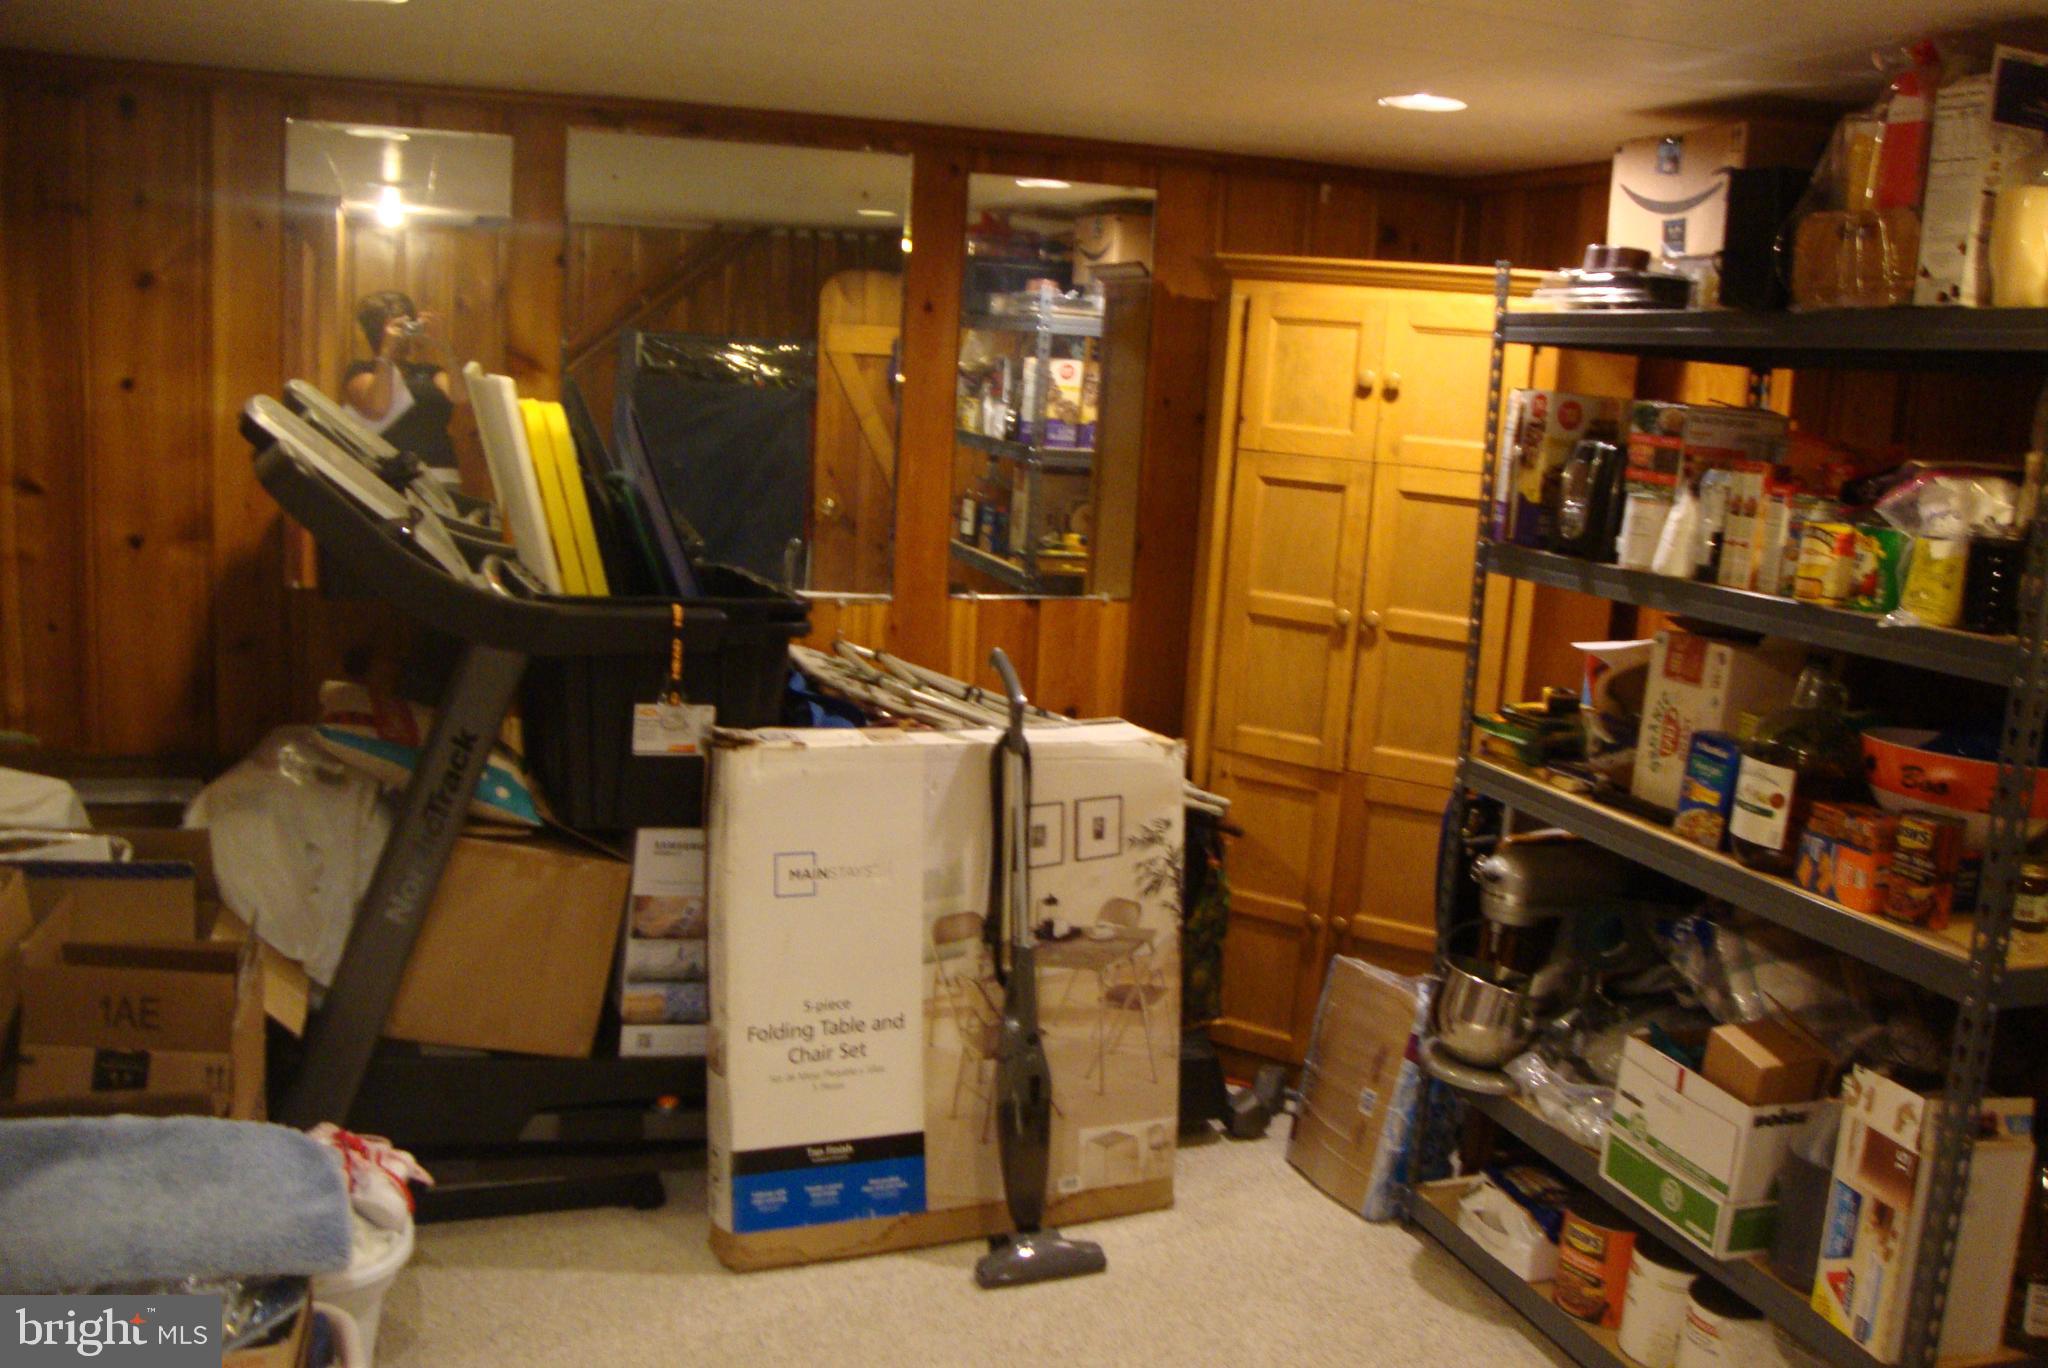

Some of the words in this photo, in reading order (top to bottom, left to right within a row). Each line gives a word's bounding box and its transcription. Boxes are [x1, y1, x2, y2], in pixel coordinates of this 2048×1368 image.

[747, 1020, 814, 1043] Folding
[821, 1016, 865, 1036] Table
[871, 1012, 905, 1032] and
[788, 1043, 833, 1065] Chair
[839, 1041, 868, 1060] Set
